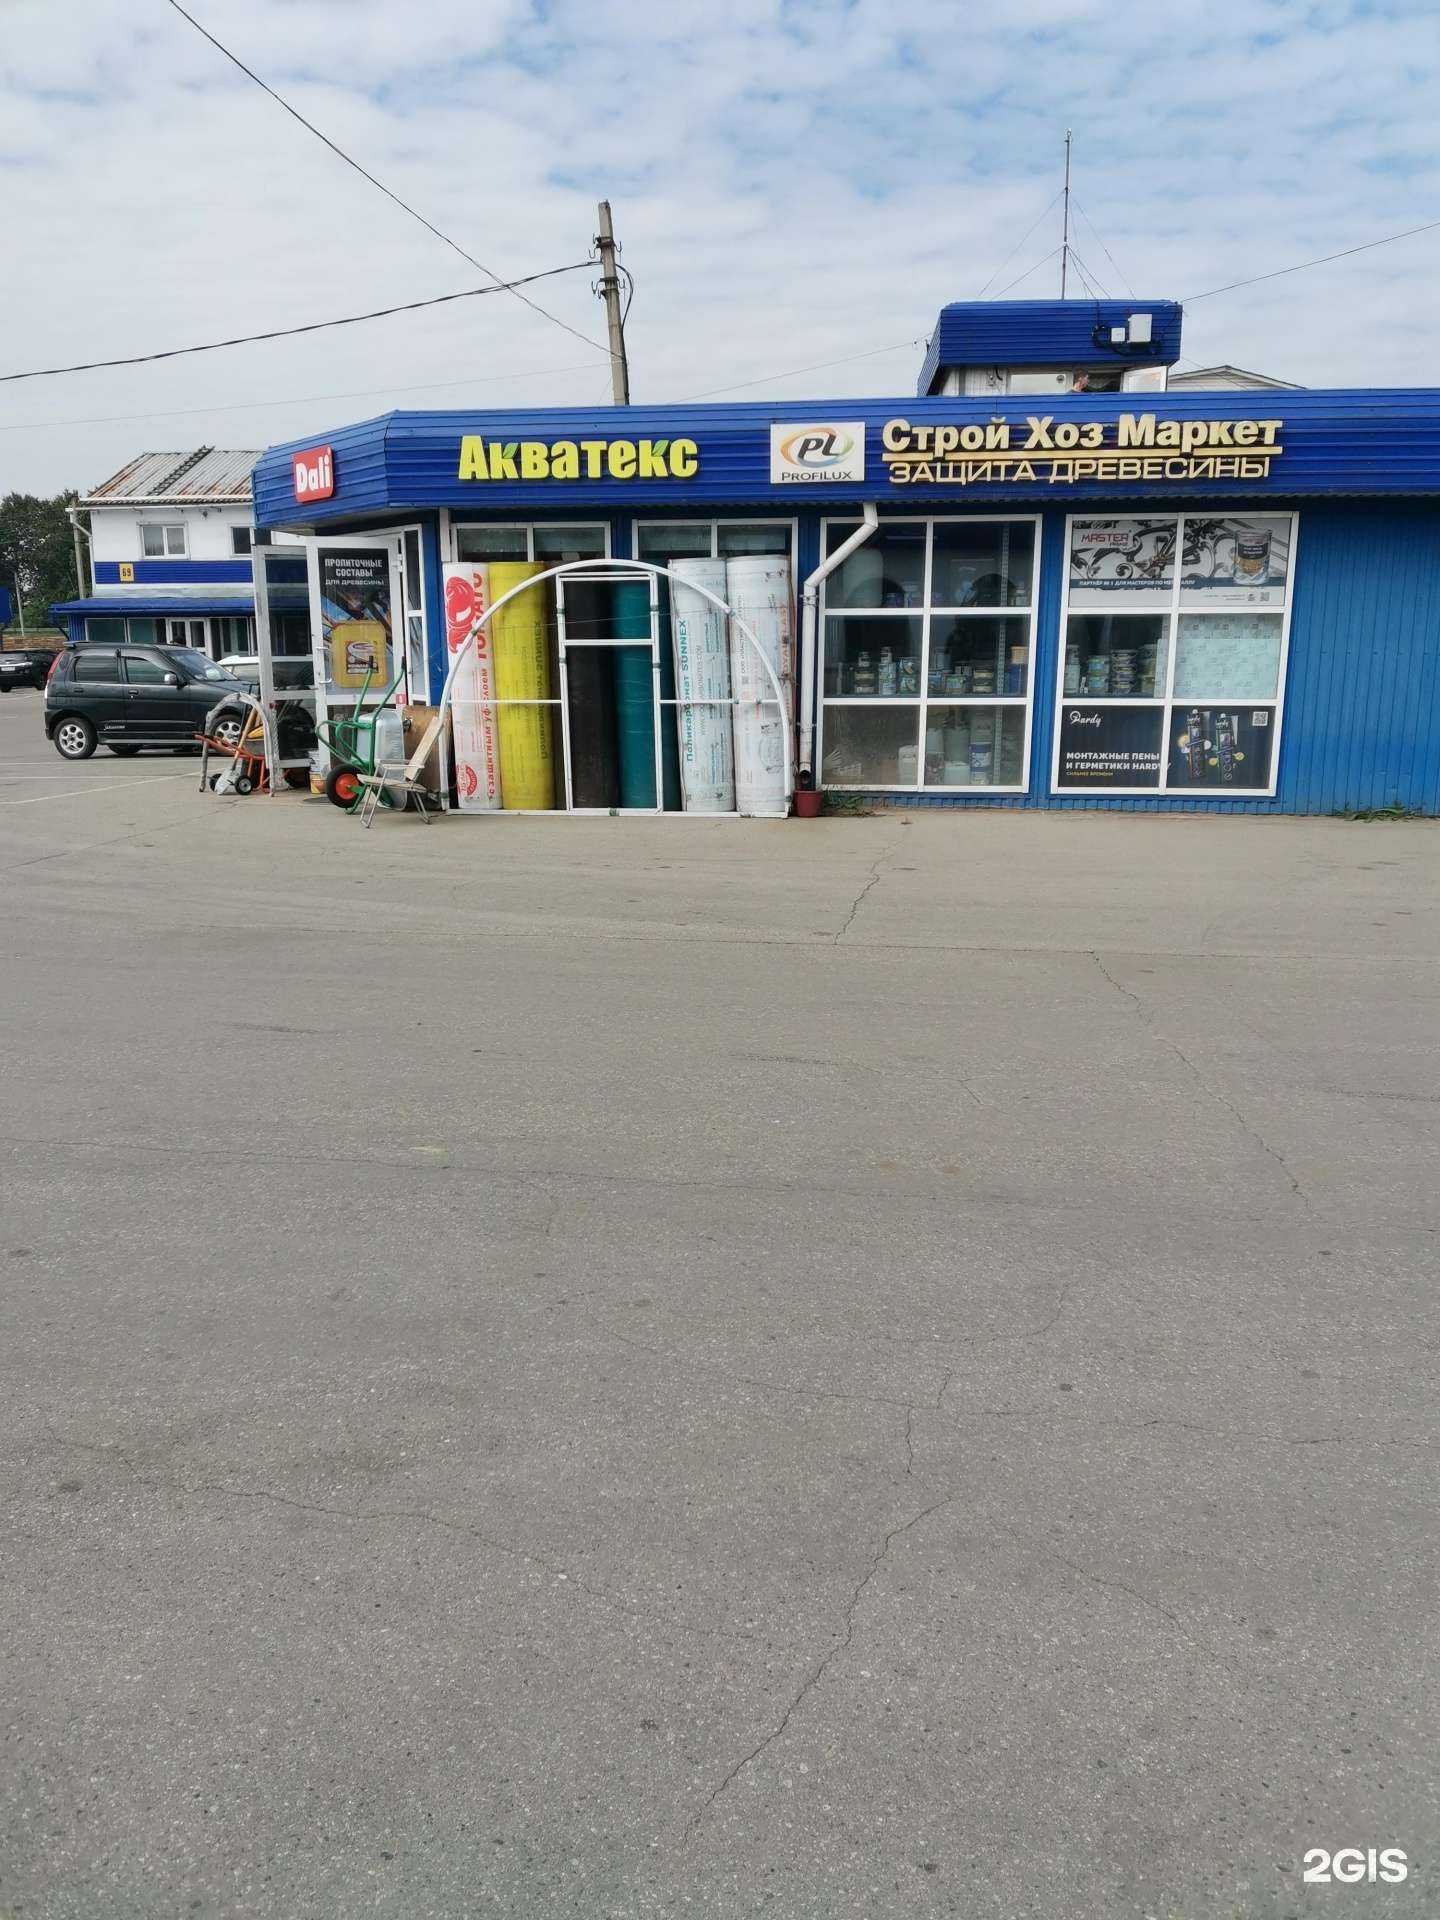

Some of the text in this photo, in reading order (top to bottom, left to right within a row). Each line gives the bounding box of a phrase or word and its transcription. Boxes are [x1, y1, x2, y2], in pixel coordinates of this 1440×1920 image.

[882, 413, 1283, 458] Строй Хоз Маркет
[458, 435, 698, 480] Акватекс
[889, 456, 1270, 486] ЗАЩИТА ДРЕВЕСИНЫ
[295, 453, 331, 493] Dali
[1080, 533, 1129, 543] MASTER
[324, 558, 383, 568] ПРОПИТОЧНЫЕ
[335, 568, 373, 577] СОСТАВЫ
[678, 620, 688, 672] SUNNEX
[484, 726, 495, 787] защитным
[1066, 752, 1160, 760] МОНТАЖНЫЕ ПЕНЫ
[1066, 762, 1073, 770] И
[1074, 762, 1131, 770] ГЕРМЕТИКИ
